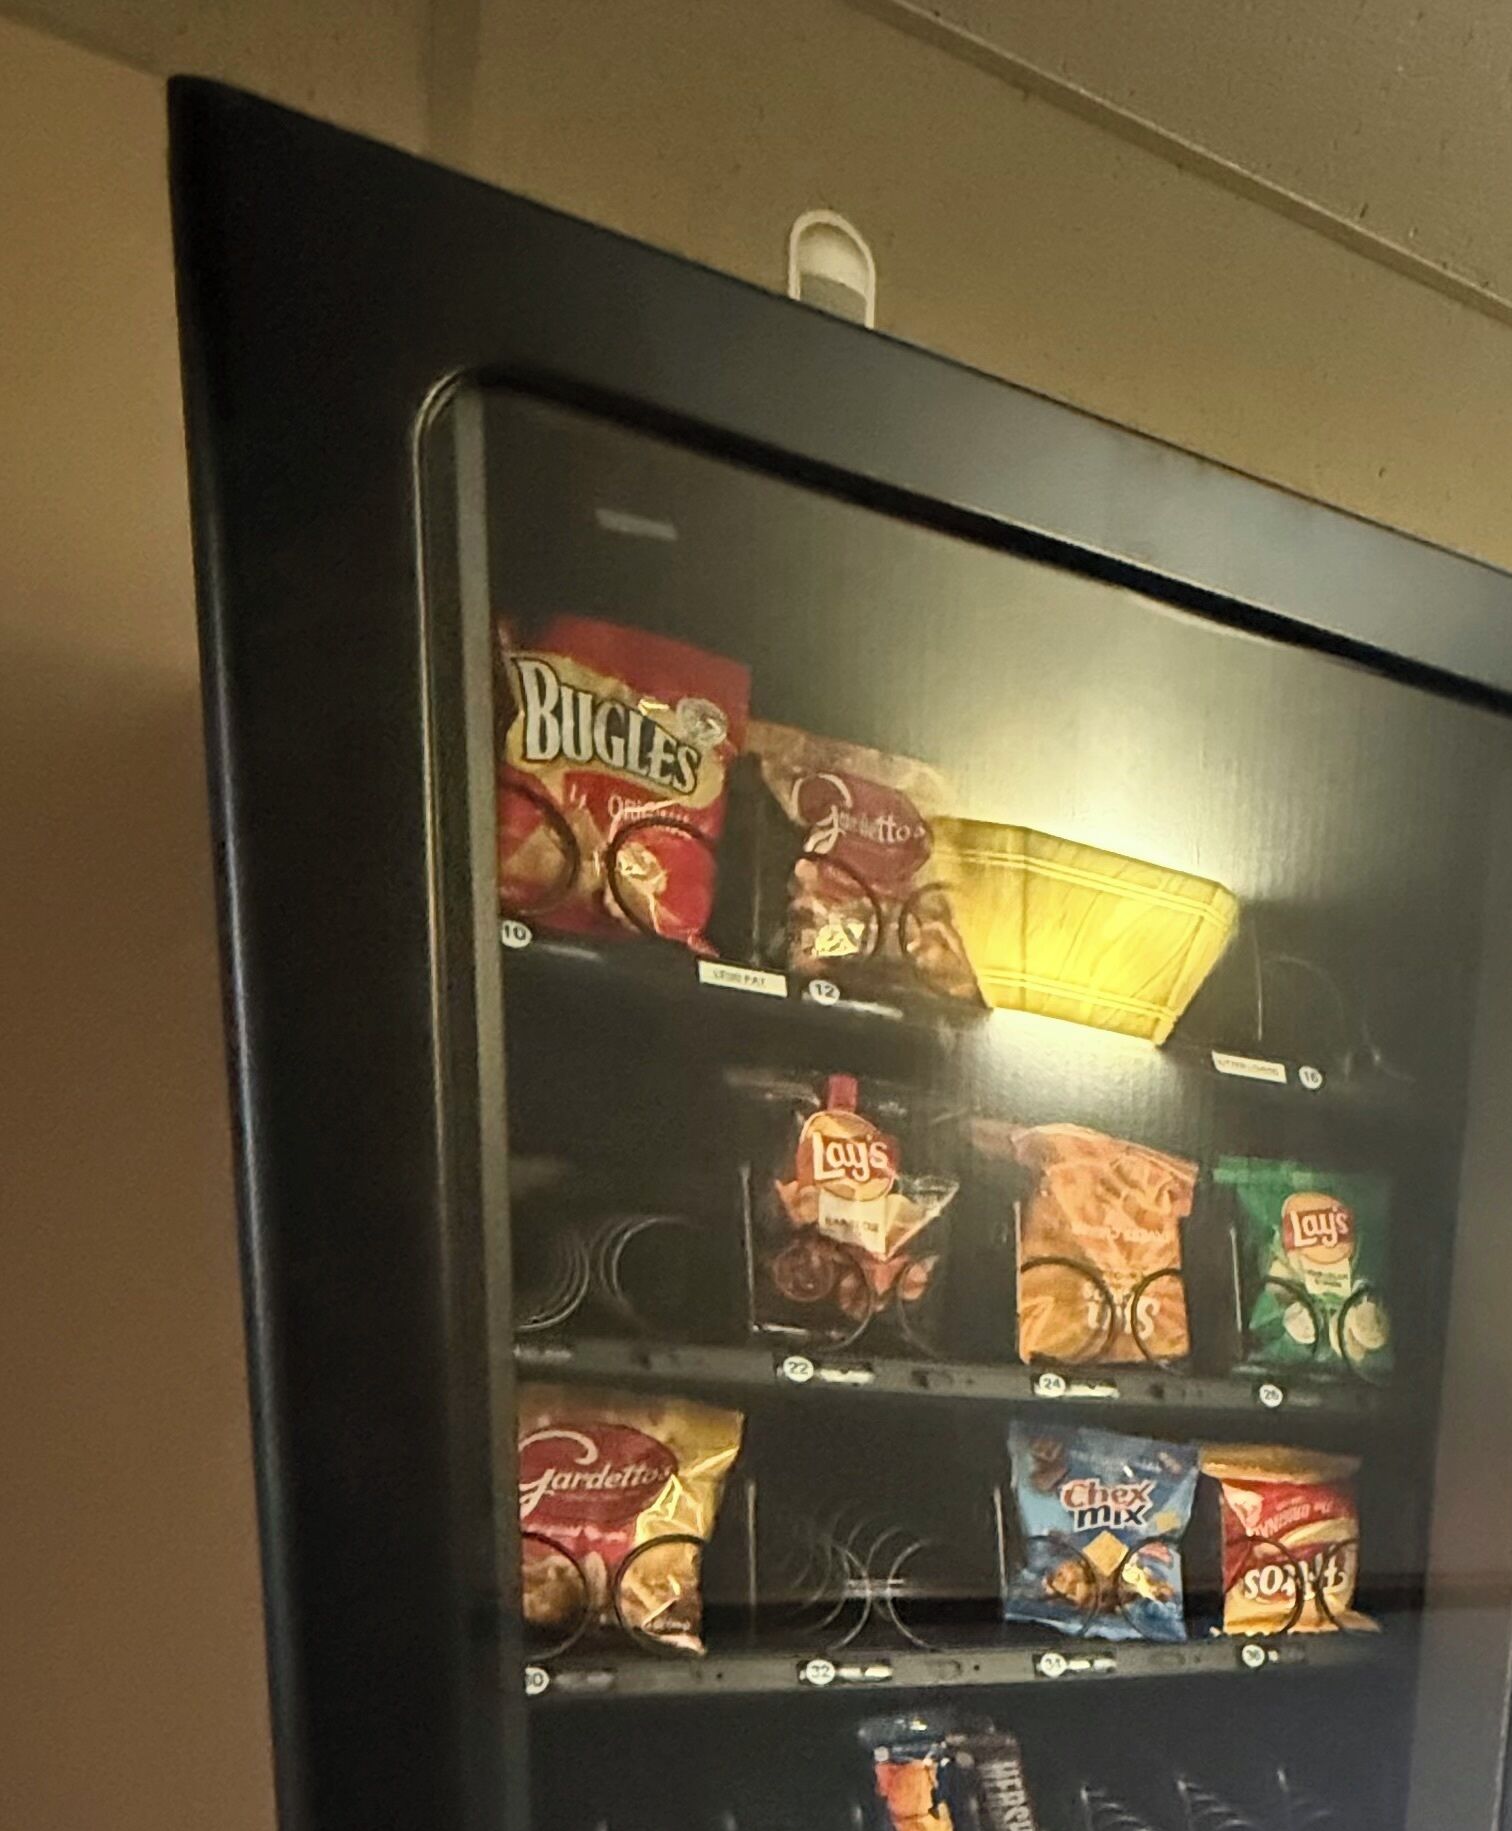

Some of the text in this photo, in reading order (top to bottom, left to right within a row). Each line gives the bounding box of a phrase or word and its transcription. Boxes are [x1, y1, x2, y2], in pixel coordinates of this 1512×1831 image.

[514, 657, 700, 794] BUGLES
[812, 1131, 889, 1183] Lay's
[1289, 1207, 1351, 1248] Lay's
[1062, 1479, 1154, 1510] Chex
